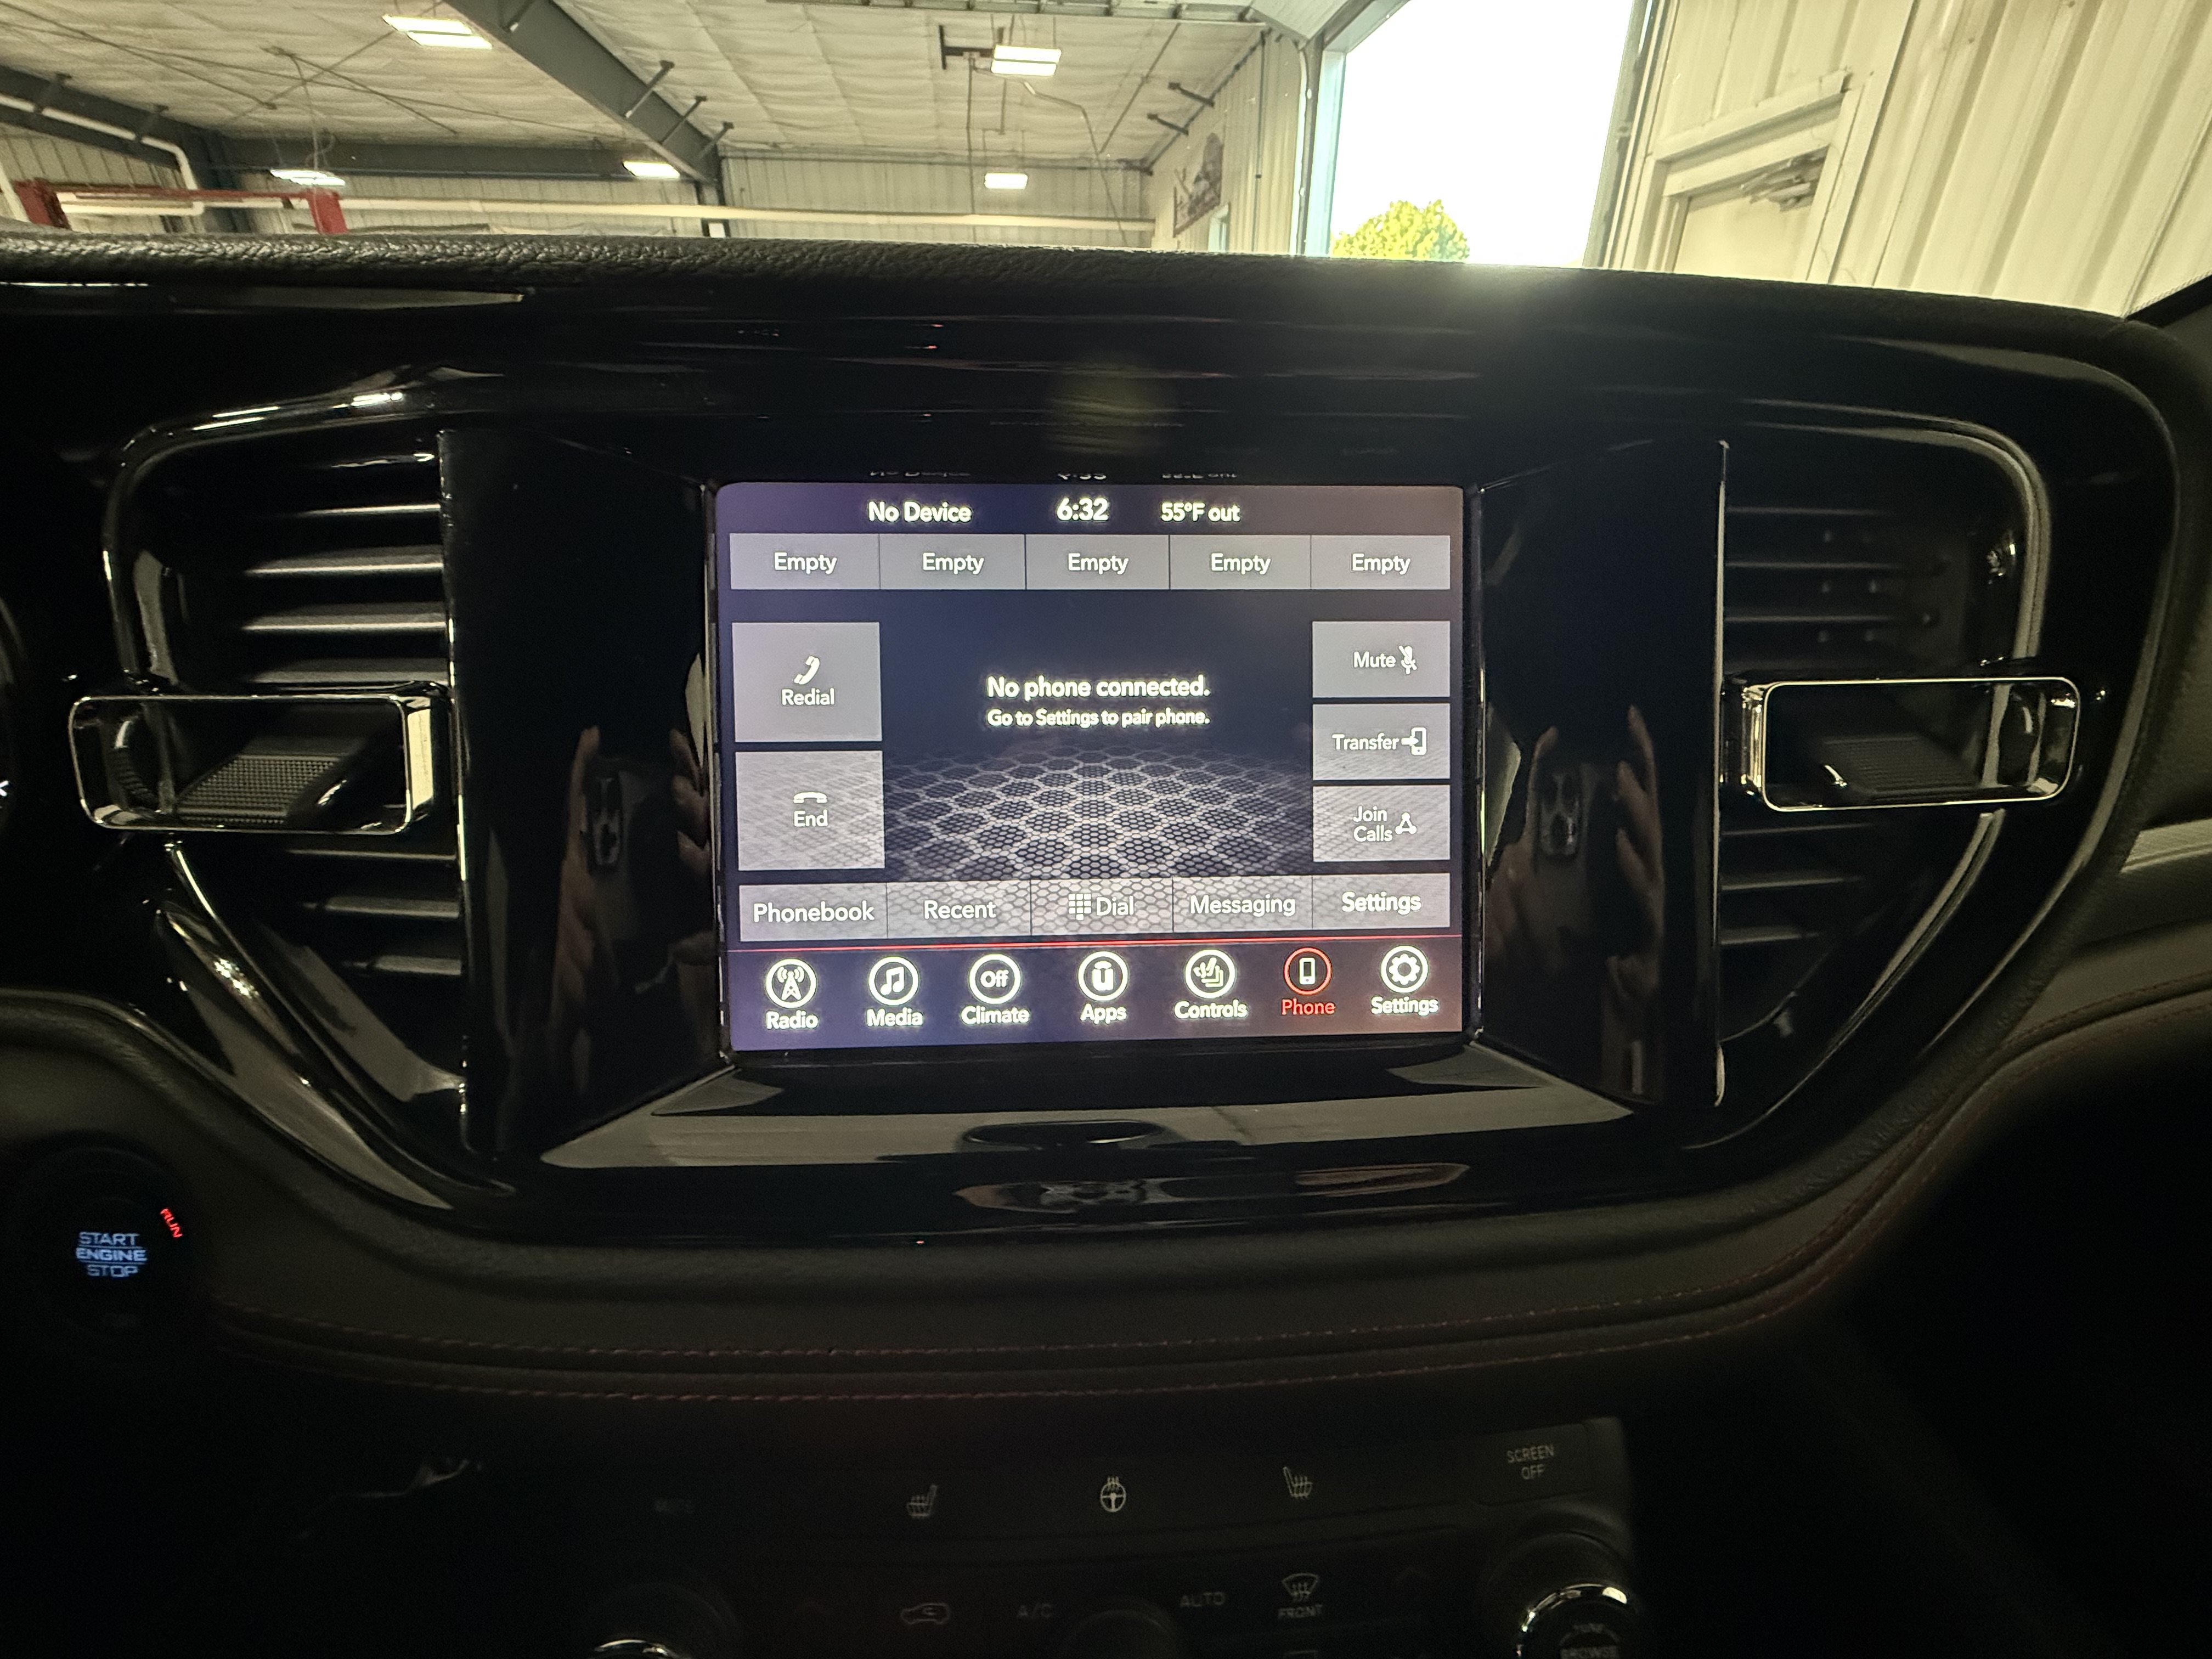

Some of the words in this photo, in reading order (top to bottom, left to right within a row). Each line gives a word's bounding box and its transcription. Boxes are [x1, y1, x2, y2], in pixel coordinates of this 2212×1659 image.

[868, 501, 900, 522] No
[904, 501, 973, 523] Device
[1056, 497, 1110, 522] 6:32
[1160, 501, 1205, 522] 55°F
[1207, 505, 1241, 523] out
[774, 551, 838, 575] Empty
[922, 552, 985, 575] Empty
[1068, 552, 1130, 575] Empty
[1211, 552, 1272, 575] Empty
[1351, 553, 1412, 575] Empty
[1353, 651, 1396, 669] Mute
[781, 688, 836, 706] Redial
[987, 675, 1020, 698] No
[1024, 675, 1092, 701] phone
[1096, 674, 1211, 697] connected.
[988, 709, 1013, 727] Go
[1015, 711, 1033, 726] to
[1035, 708, 1099, 729] Settings
[1101, 710, 1119, 726] to
[1121, 709, 1153, 729] pair
[1155, 707, 1211, 727] phone.
[1332, 732, 1400, 752] Transfer
[793, 809, 828, 827] End
[1353, 806, 1387, 823] Join
[1353, 825, 1393, 843] Calls
[754, 901, 875, 923] Phonebook
[924, 900, 996, 919] Recent
[1096, 896, 1134, 916] Dial
[1190, 894, 1296, 917] Messaging
[1341, 891, 1422, 915] Settings
[980, 969, 1009, 989] Off
[961, 1005, 1030, 1025] Climate
[1080, 1002, 1127, 1025] Apps
[1174, 1000, 1248, 1019] Controls
[1281, 1000, 1336, 1015] Phone
[1370, 996, 1439, 1016] Settings
[766, 1011, 819, 1030] Radio
[866, 1007, 924, 1027] Media
[160, 1207, 183, 1238] RUN
[78, 1232, 140, 1246] START
[75, 1247, 148, 1261] ENGINE
[87, 1265, 139, 1278] STOP
[1506, 1444, 1555, 1464] SCREEN
[1521, 1464, 1546, 1480] OFF
[1180, 1591, 1227, 1607] AUTO
[1016, 1602, 1054, 1619] A/C
[1278, 1604, 1323, 1620] FRONT
